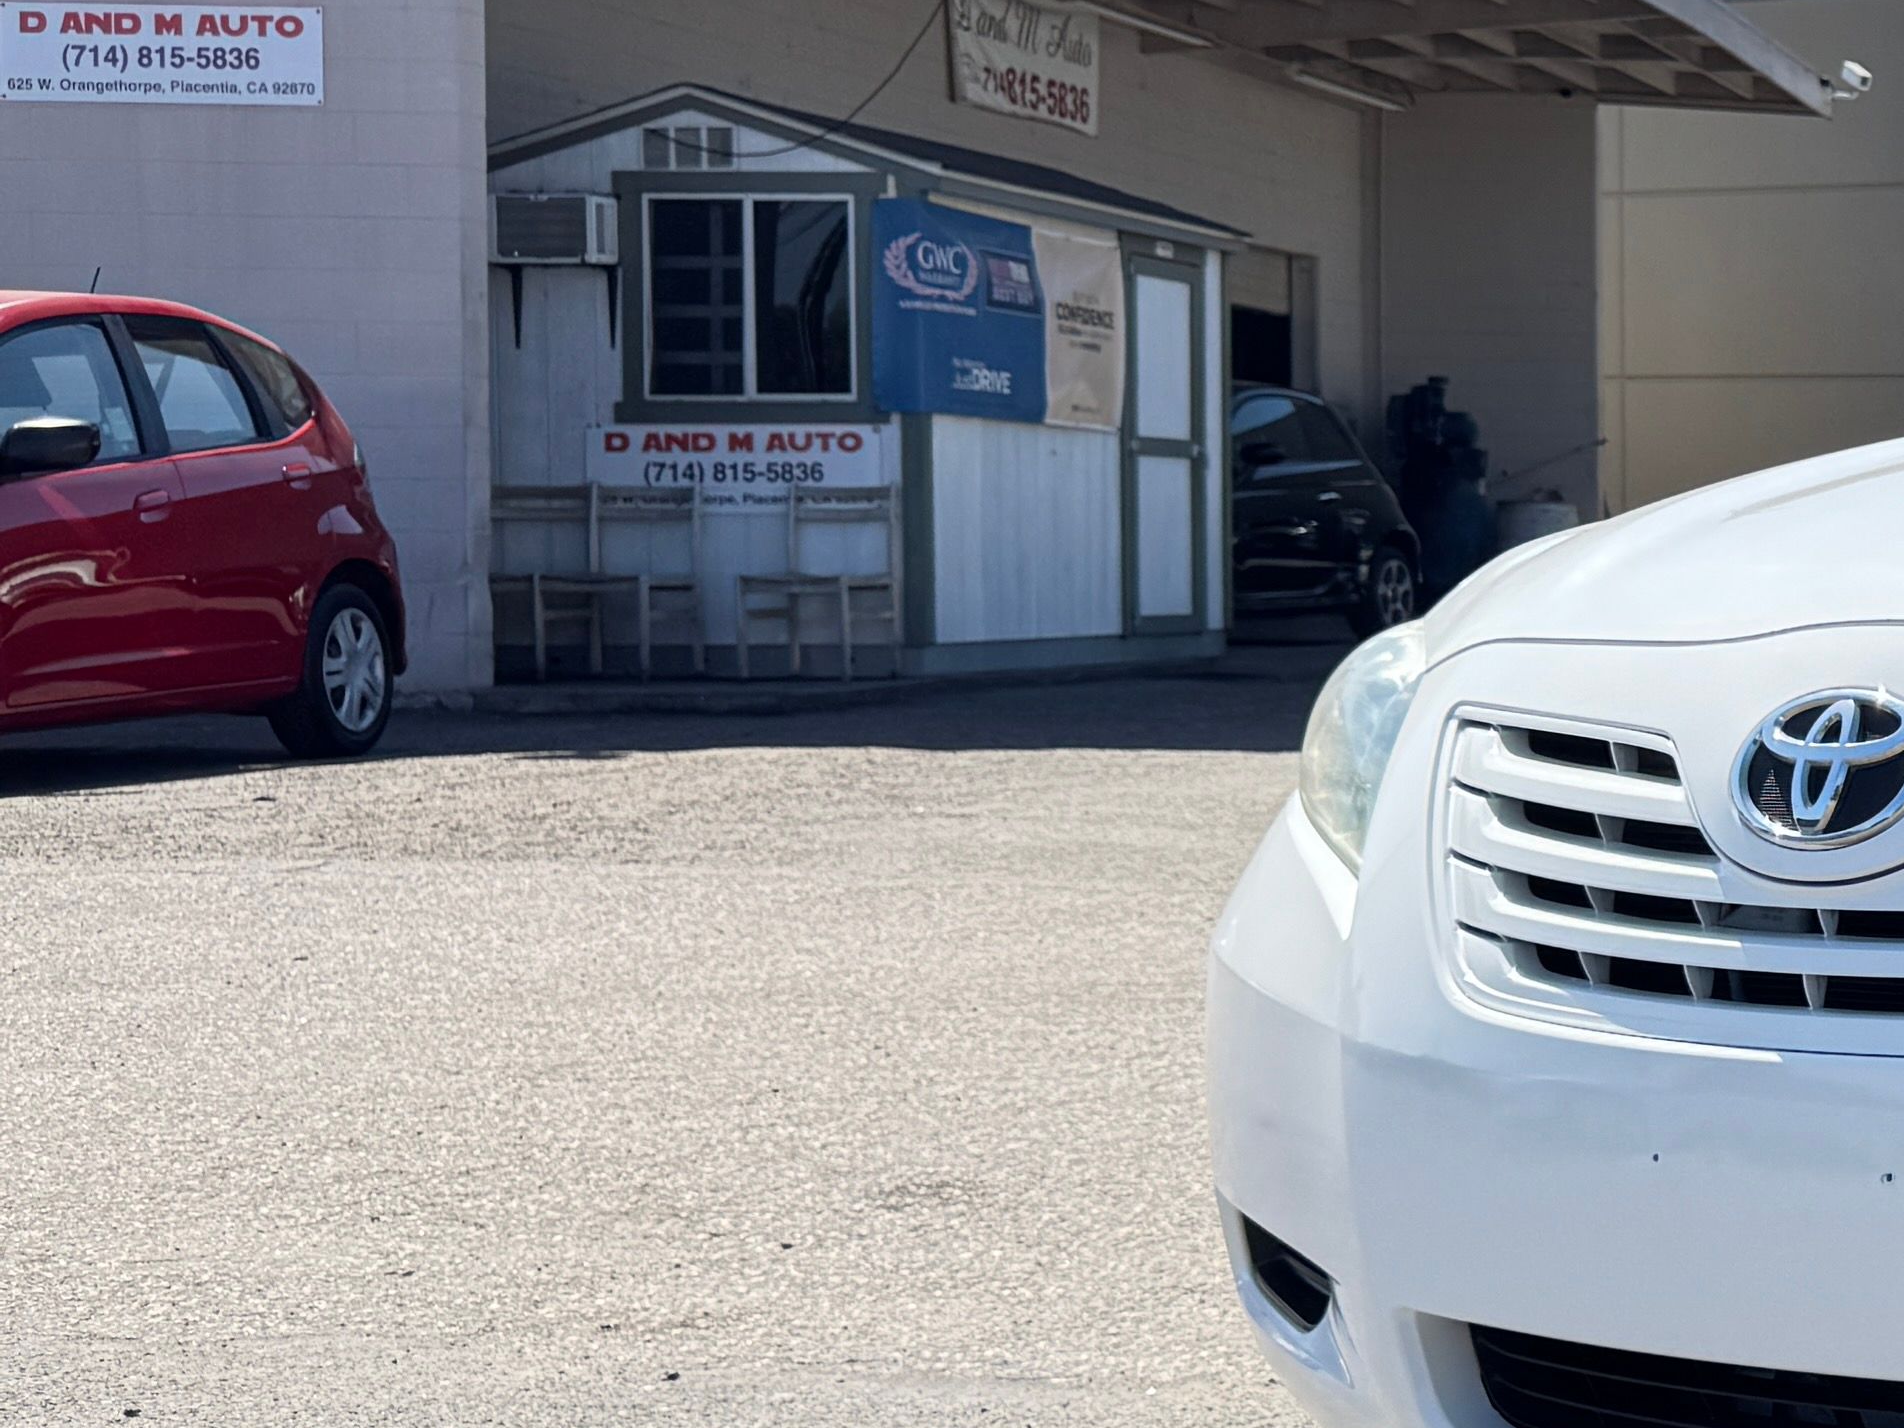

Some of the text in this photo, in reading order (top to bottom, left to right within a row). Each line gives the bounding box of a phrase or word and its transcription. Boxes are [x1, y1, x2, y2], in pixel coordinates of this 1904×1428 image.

[19, 10, 304, 39] D AND M AUTO
[1046, 14, 1092, 68] Auto
[62, 44, 260, 73] (714) 815-5836
[37, 78, 55, 91] W.
[59, 78, 165, 96] Orangethorpe,
[171, 80, 242, 96] Placentia,
[246, 83, 268, 94] CA
[917, 240, 963, 275] GWC
[604, 431, 863, 453] D AND M AUTO
[644, 461, 824, 486] (714) 815-5836
